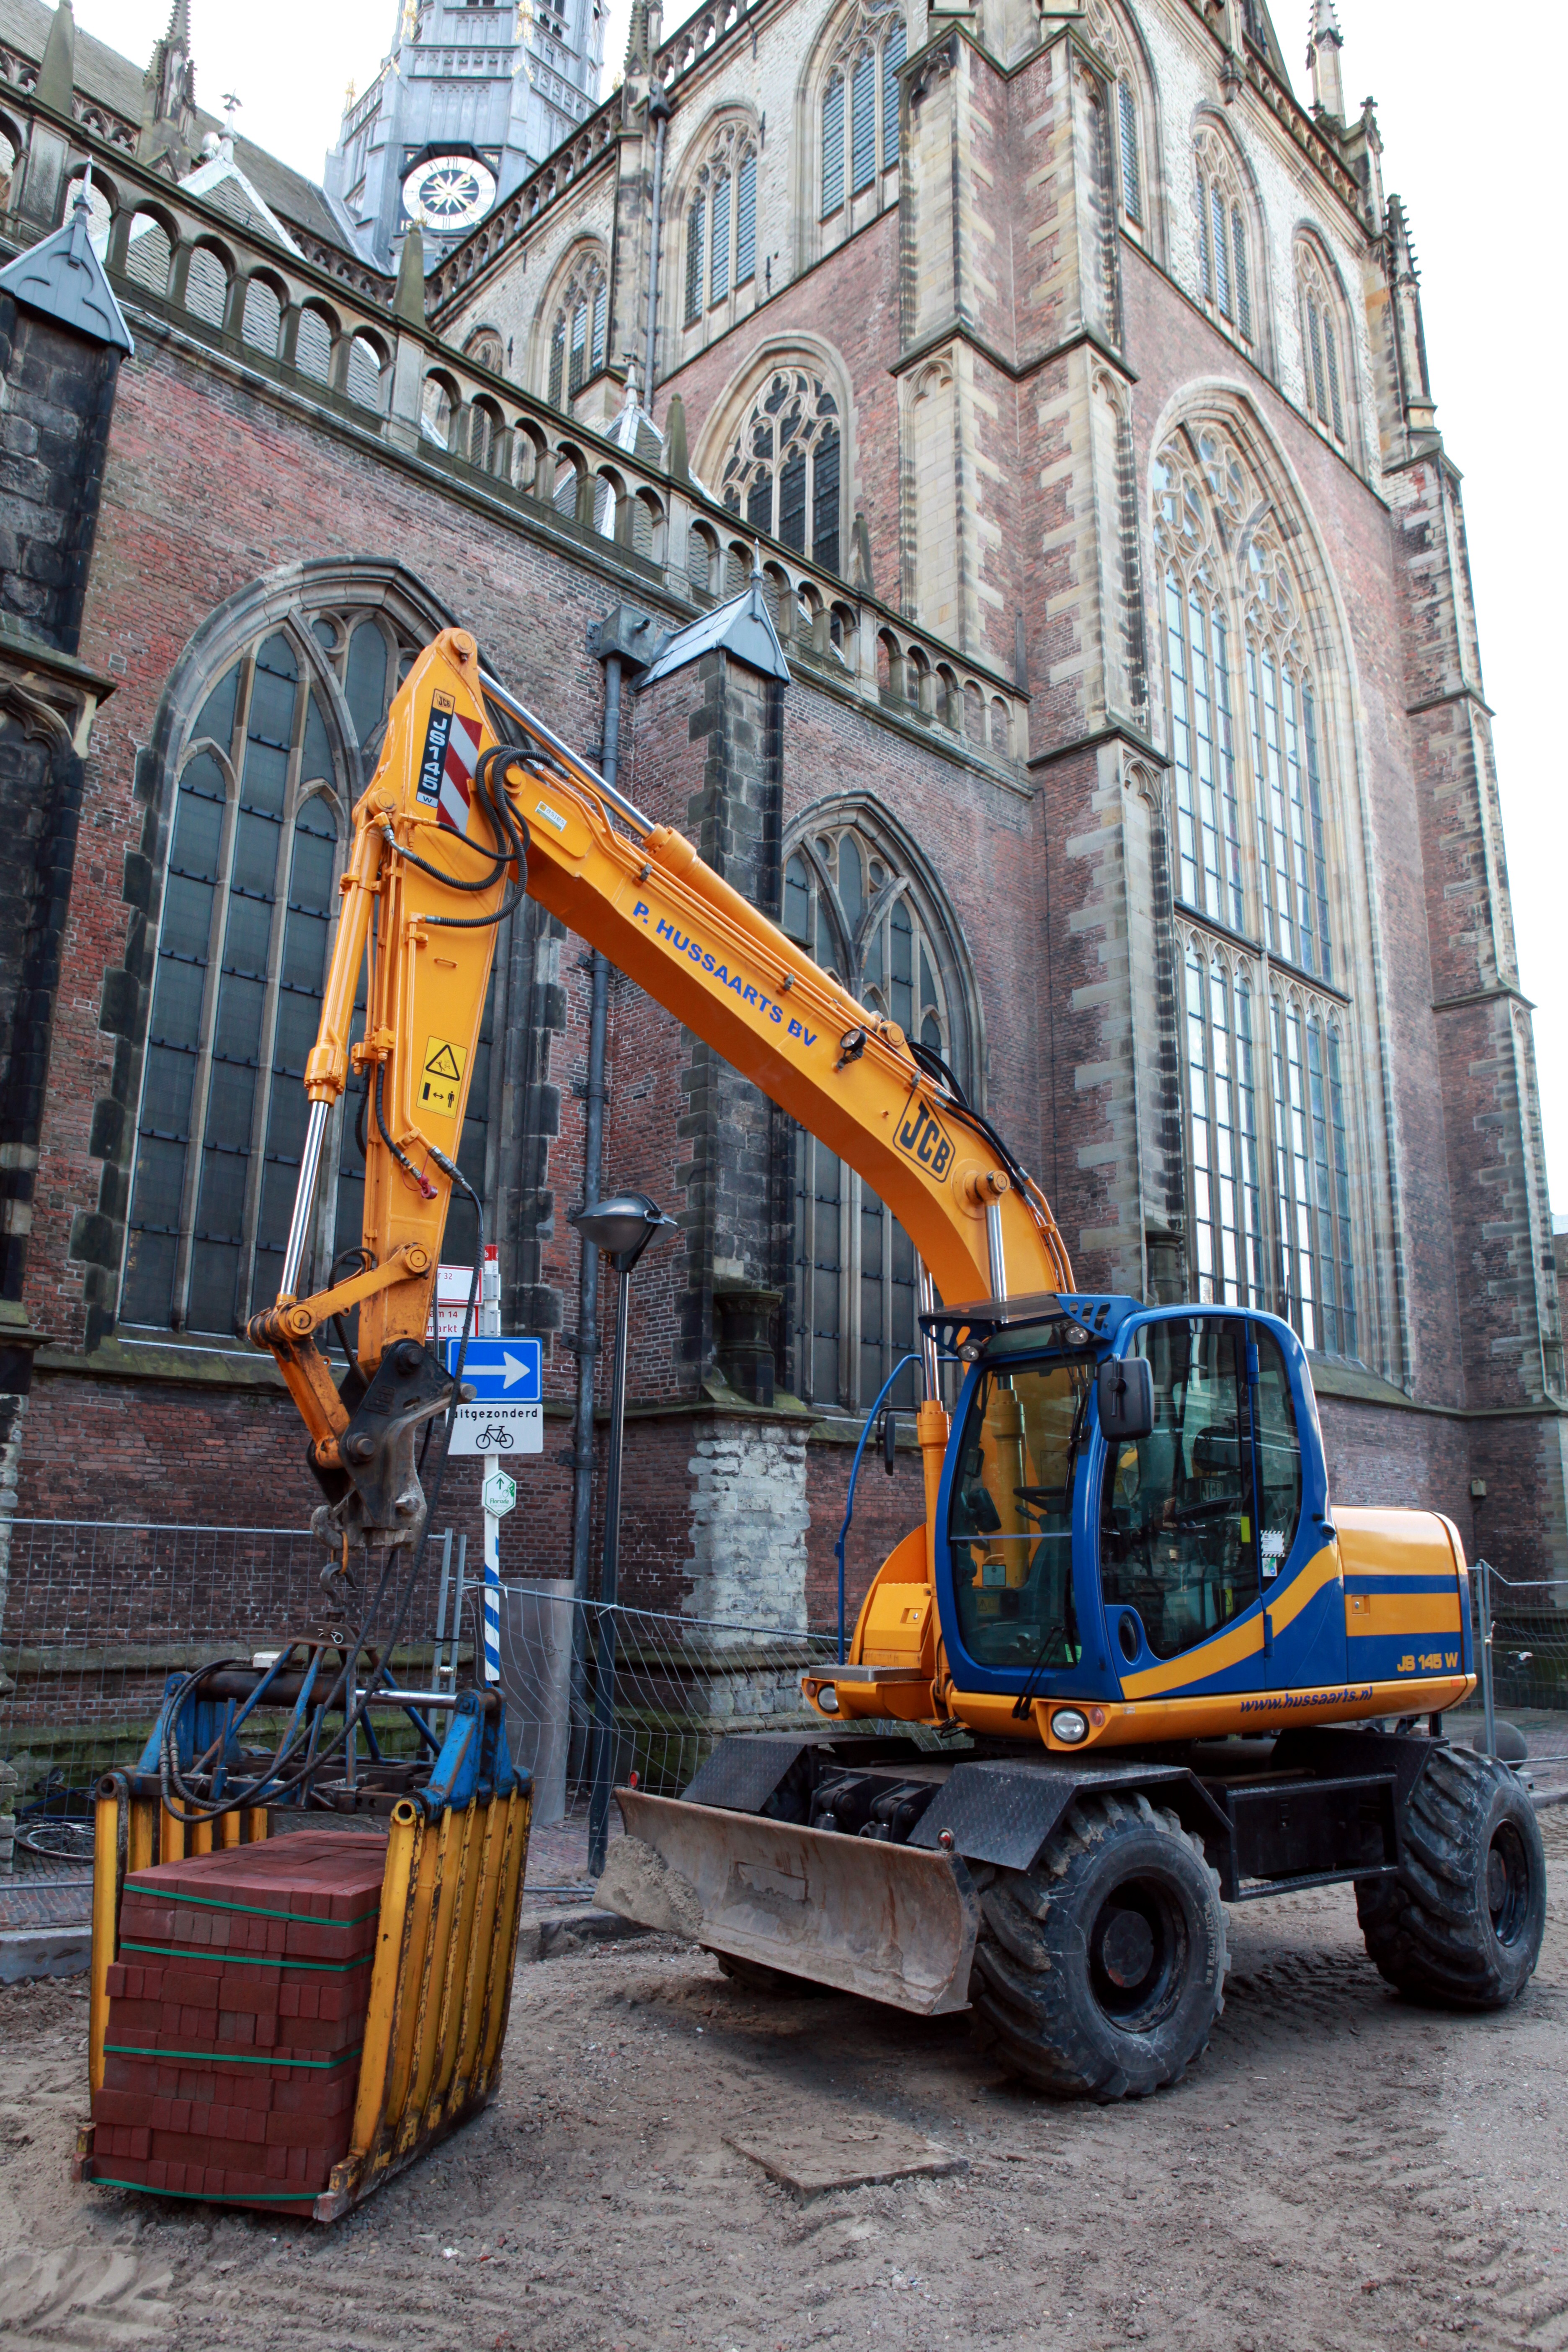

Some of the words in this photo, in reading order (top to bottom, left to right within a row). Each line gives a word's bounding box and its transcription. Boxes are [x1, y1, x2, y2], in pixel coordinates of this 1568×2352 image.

[438, 696, 450, 707] JCB
[422, 718, 447, 790] JS145
[633, 902, 649, 924] P.
[656, 919, 783, 1023] HUSSAARTS
[787, 1019, 817, 1046] BV
[900, 1100, 950, 1173] JCB
[428, 1324, 457, 1333] markt
[1202, 1481, 1222, 1500] JCB
[1397, 1655, 1415, 1672] JS
[1418, 1653, 1442, 1670] 145
[1445, 1652, 1458, 1668] W
[1240, 1685, 1373, 1712] www.hussaarts.nl
